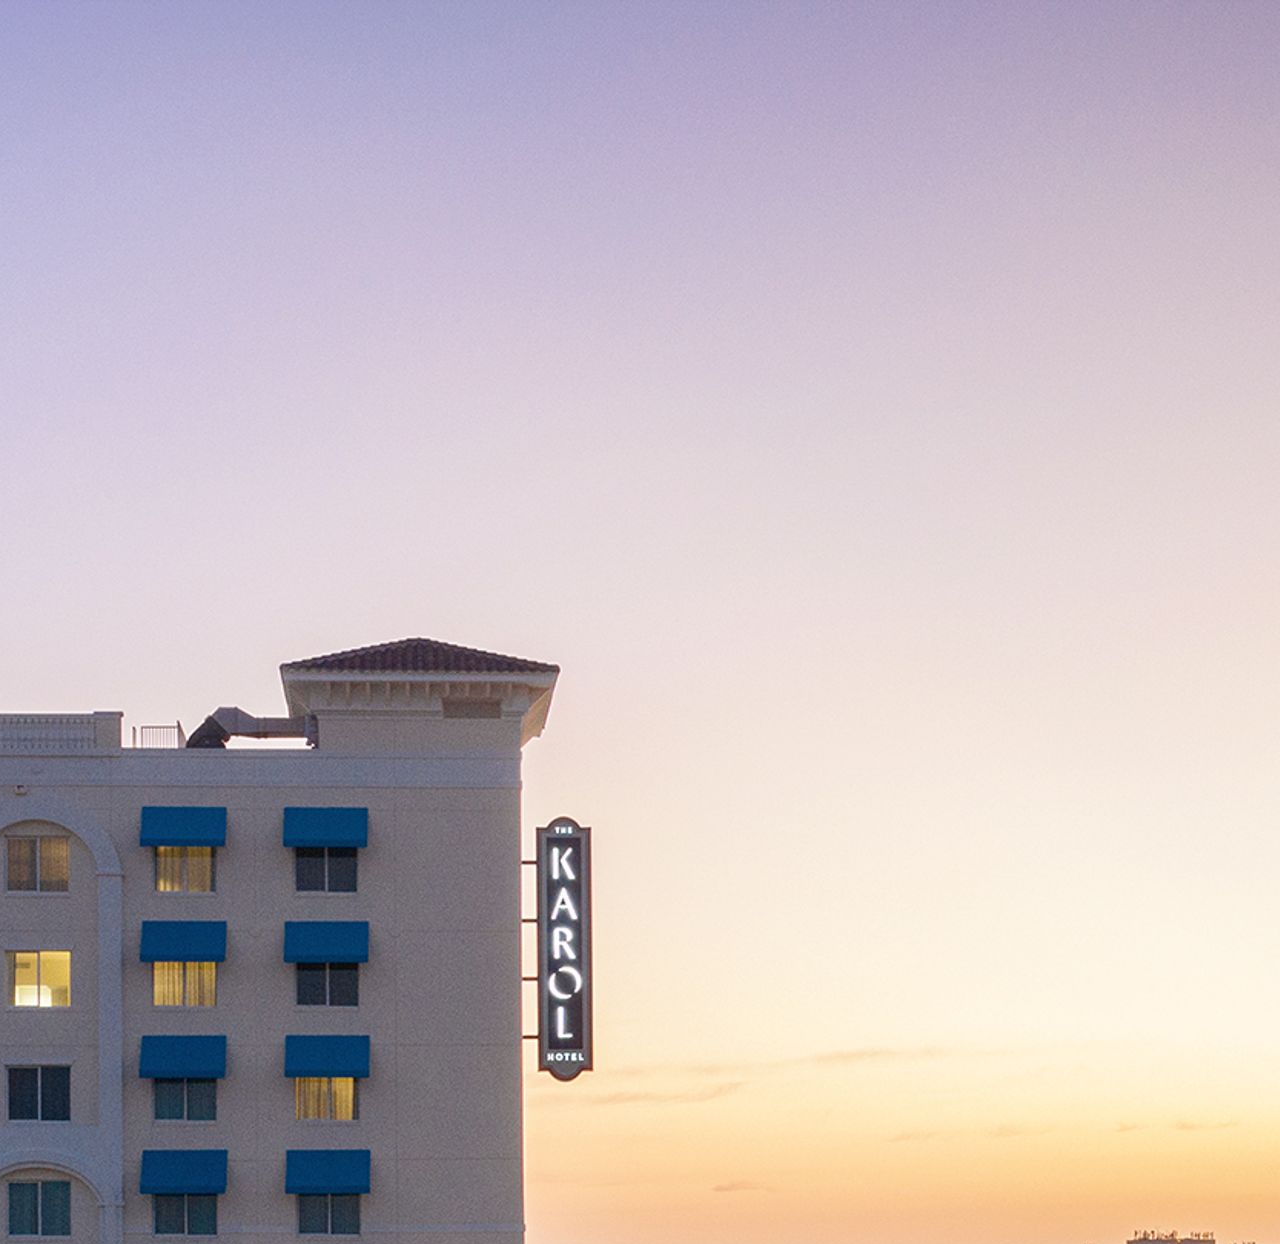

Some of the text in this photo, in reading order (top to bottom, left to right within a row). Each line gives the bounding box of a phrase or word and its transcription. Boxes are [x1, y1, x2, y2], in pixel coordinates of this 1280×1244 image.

[555, 826, 573, 835] THE
[549, 847, 582, 1039] KAROL
[547, 1052, 585, 1062] HOTEL
